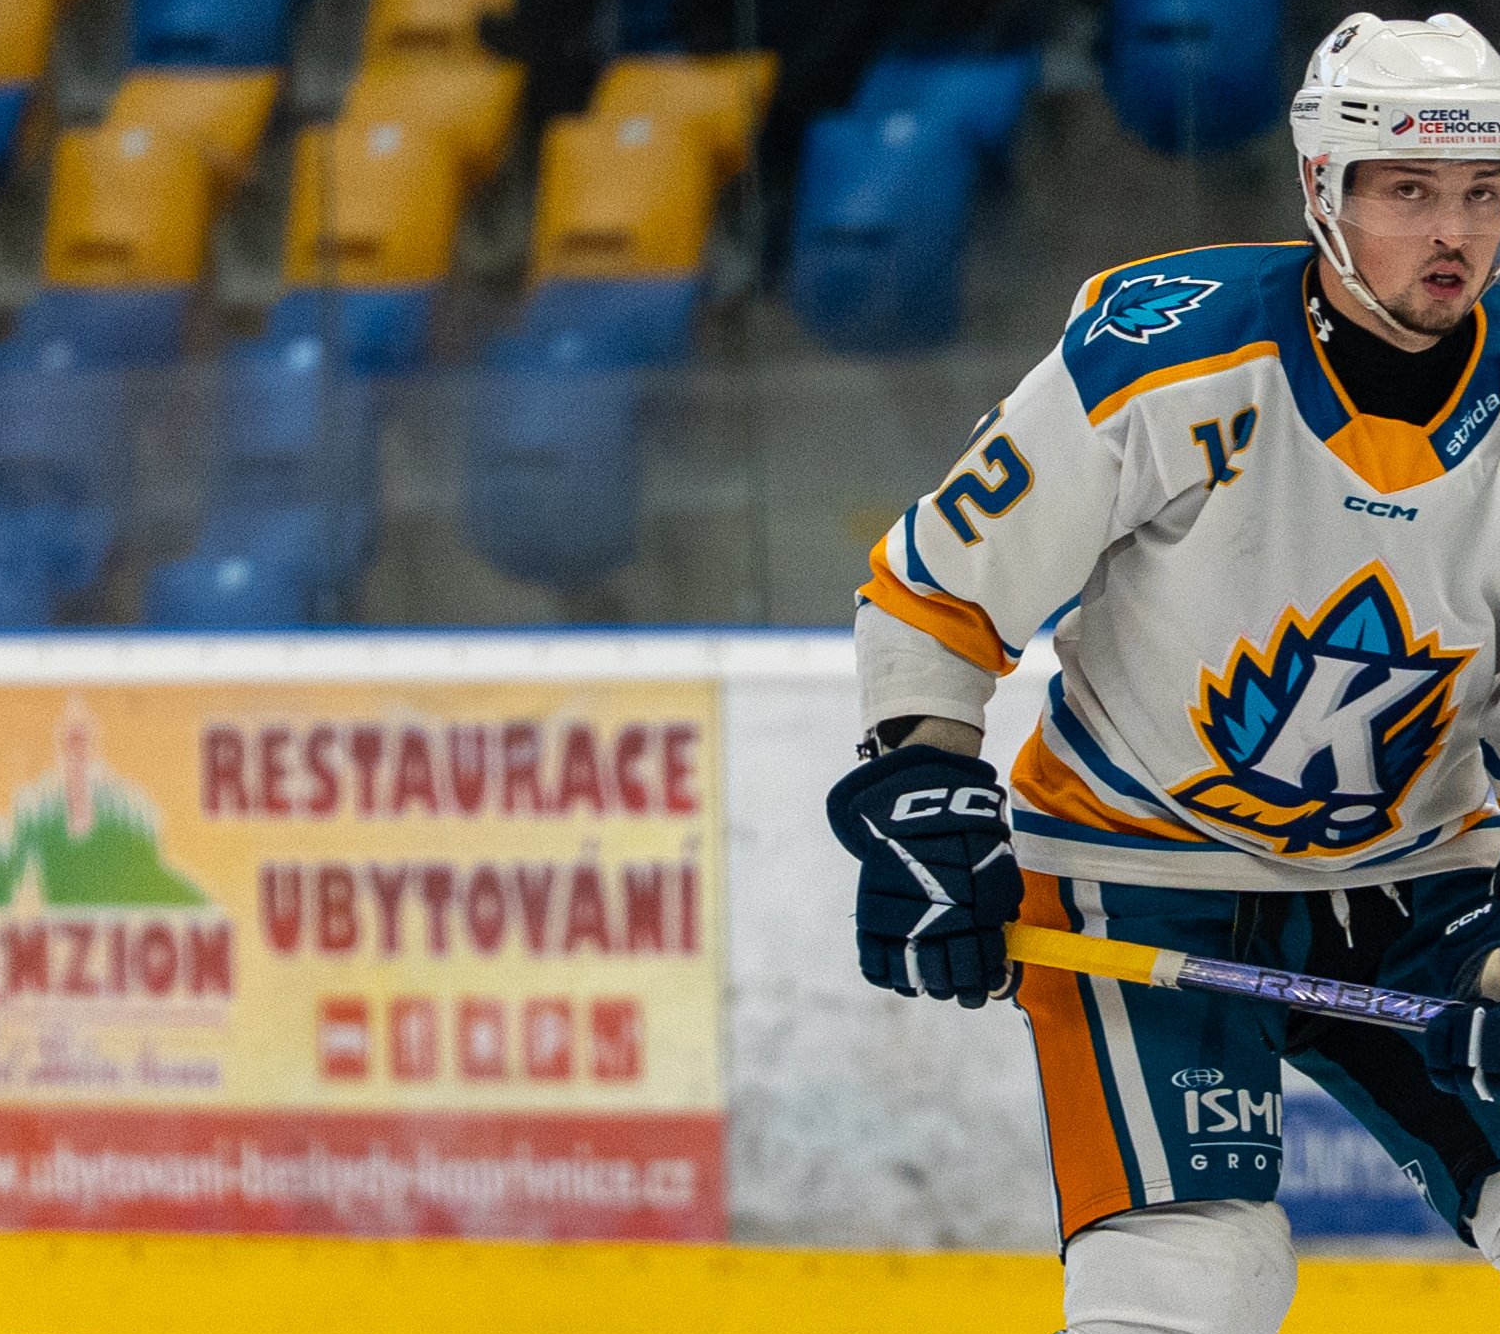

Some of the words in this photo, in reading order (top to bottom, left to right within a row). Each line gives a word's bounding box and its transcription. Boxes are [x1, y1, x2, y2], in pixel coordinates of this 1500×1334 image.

[1418, 109, 1470, 122] CZECH
[932, 400, 1036, 548] 2
[1342, 495, 1419, 522] CCM
[201, 720, 702, 819] RESTAURACE
[889, 785, 1008, 822] CC
[258, 835, 700, 957] UBYTOVÁNÍ
[1444, 902, 1494, 936] CCM
[1184, 1088, 1282, 1138] ISM
